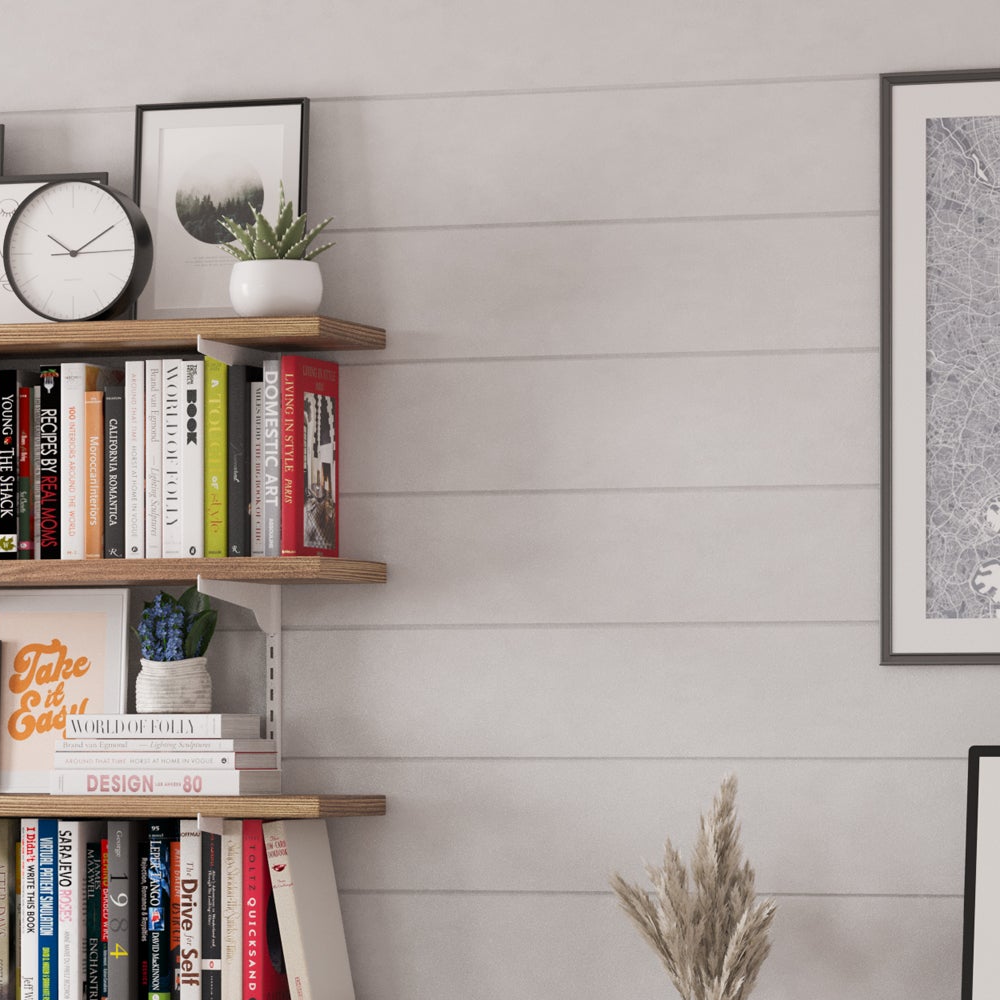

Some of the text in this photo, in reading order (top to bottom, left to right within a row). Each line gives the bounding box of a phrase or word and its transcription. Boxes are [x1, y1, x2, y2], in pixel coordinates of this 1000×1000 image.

[187, 389, 197, 446] BOOK
[264, 371, 278, 506] DOMESTIC ART
[284, 373, 294, 504] LIVING IN STYLE PARIS
[0, 394, 15, 518] YOUNG THE SHACK
[109, 418, 118, 526] CALIFORNIA ROMANTICA
[148, 410, 159, 498] Egmond Lighting
[166, 366, 178, 528] WORLD OF FOLLY
[40, 409, 57, 547] RECIPES BY REAL MOMS
[9, 639, 91, 694] Take
[44, 682, 65, 708] it
[71, 719, 195, 734] WORLD OF FOLLY
[87, 775, 203, 792] DESIGN 80
[26, 834, 36, 862] Didn't
[39, 837, 54, 866] VIRTUAL
[59, 830, 72, 922] SARAJEVO ROSES
[26, 865, 36, 890] WRITE
[26, 891, 36, 909] THIS
[39, 867, 54, 895] PATIENT
[150, 840, 162, 952] LEPER TANGO DAVID
[26, 911, 36, 934] BOOK
[39, 896, 54, 936] SIMULATION
[181, 879, 199, 986] Drive Self
[248, 897, 257, 991] QUICKSAND
[22, 976, 34, 991] Jeff
